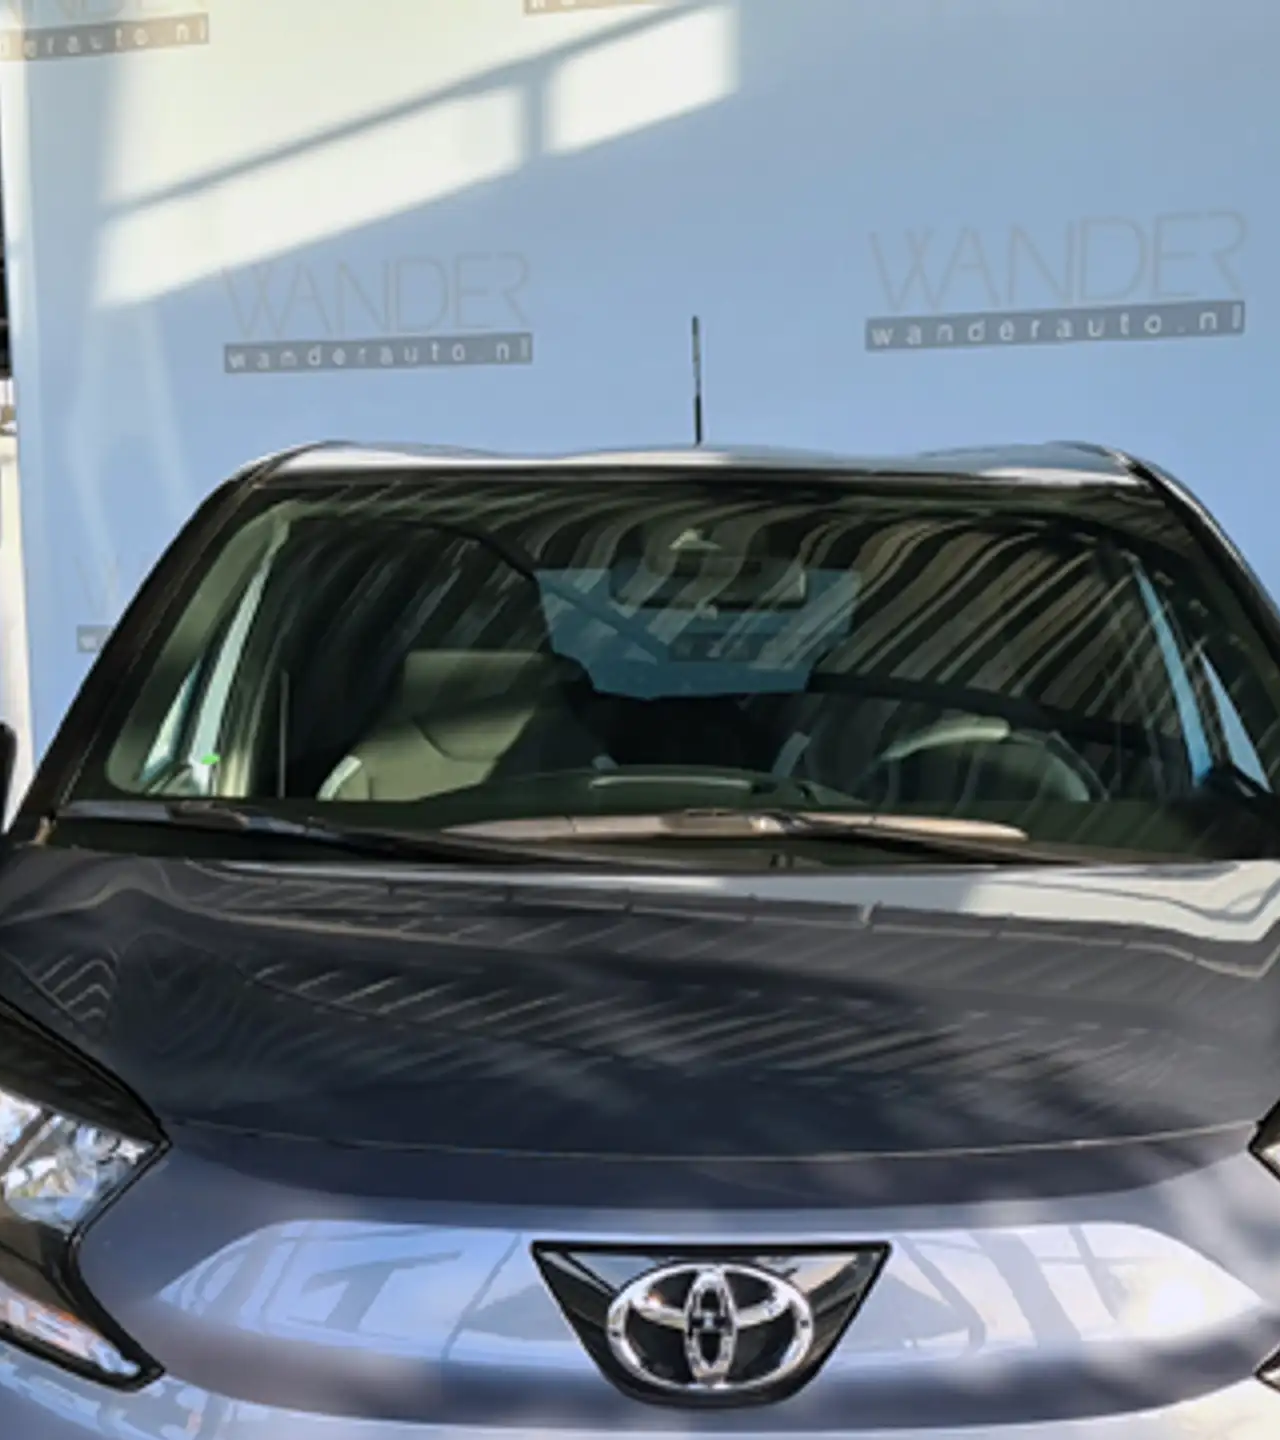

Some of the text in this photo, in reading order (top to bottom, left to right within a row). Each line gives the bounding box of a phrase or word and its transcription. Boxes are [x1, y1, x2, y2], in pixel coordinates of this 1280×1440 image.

[868, 210, 1247, 312] WANDER
[223, 251, 531, 338] WANDER
[871, 303, 1241, 346] wanderauto.nl
[227, 336, 529, 370] wanderauto.nl
